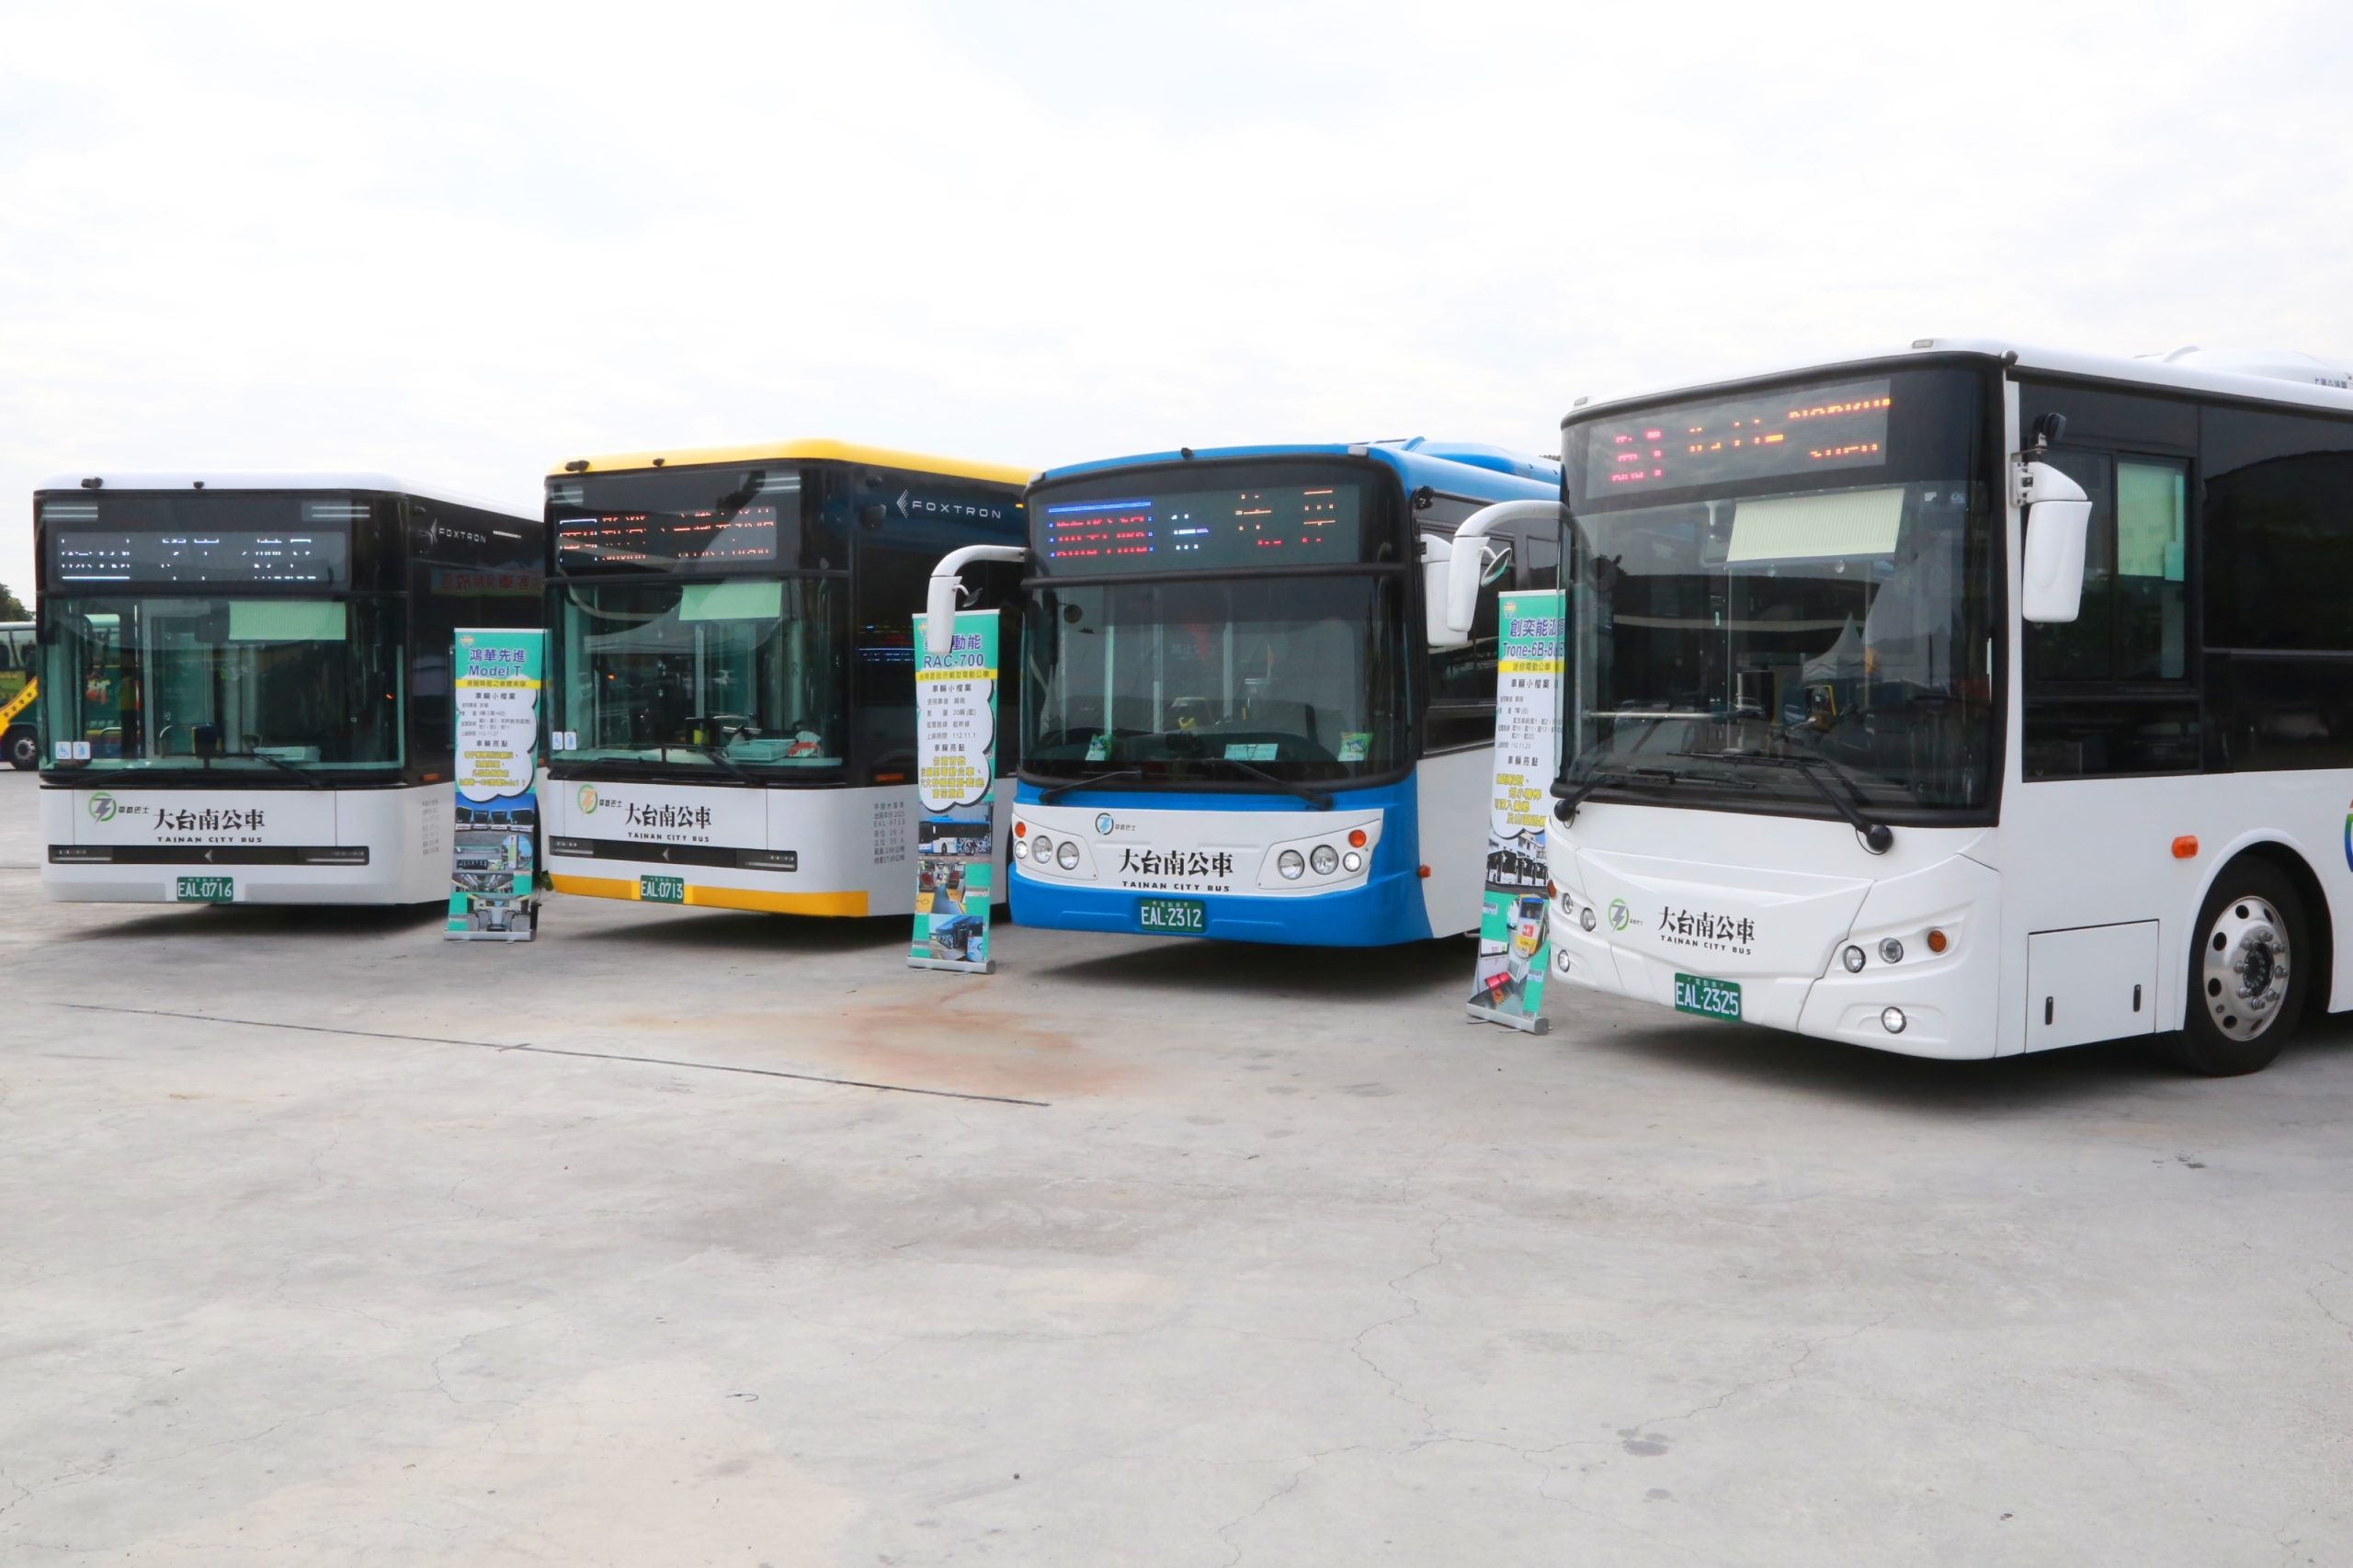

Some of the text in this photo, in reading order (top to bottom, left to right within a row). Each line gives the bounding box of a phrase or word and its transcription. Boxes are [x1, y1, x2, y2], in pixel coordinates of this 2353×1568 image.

[912, 501, 1001, 519] FOXTRON
[439, 528, 486, 543] FOXTRON
[470, 648, 526, 663] 鴻華先進
[923, 653, 984, 668] RAC-700
[469, 665, 521, 676] Model T
[153, 809, 266, 831] 大台南公車
[625, 802, 711, 829] 大台南公車
[628, 832, 662, 840] TAINAN
[1119, 848, 1233, 878] 大台南公車
[1122, 881, 1167, 890] TAINAN
[1658, 906, 1755, 944] 大台南公車
[1661, 935, 1751, 955] TAINAN CITY BUS
